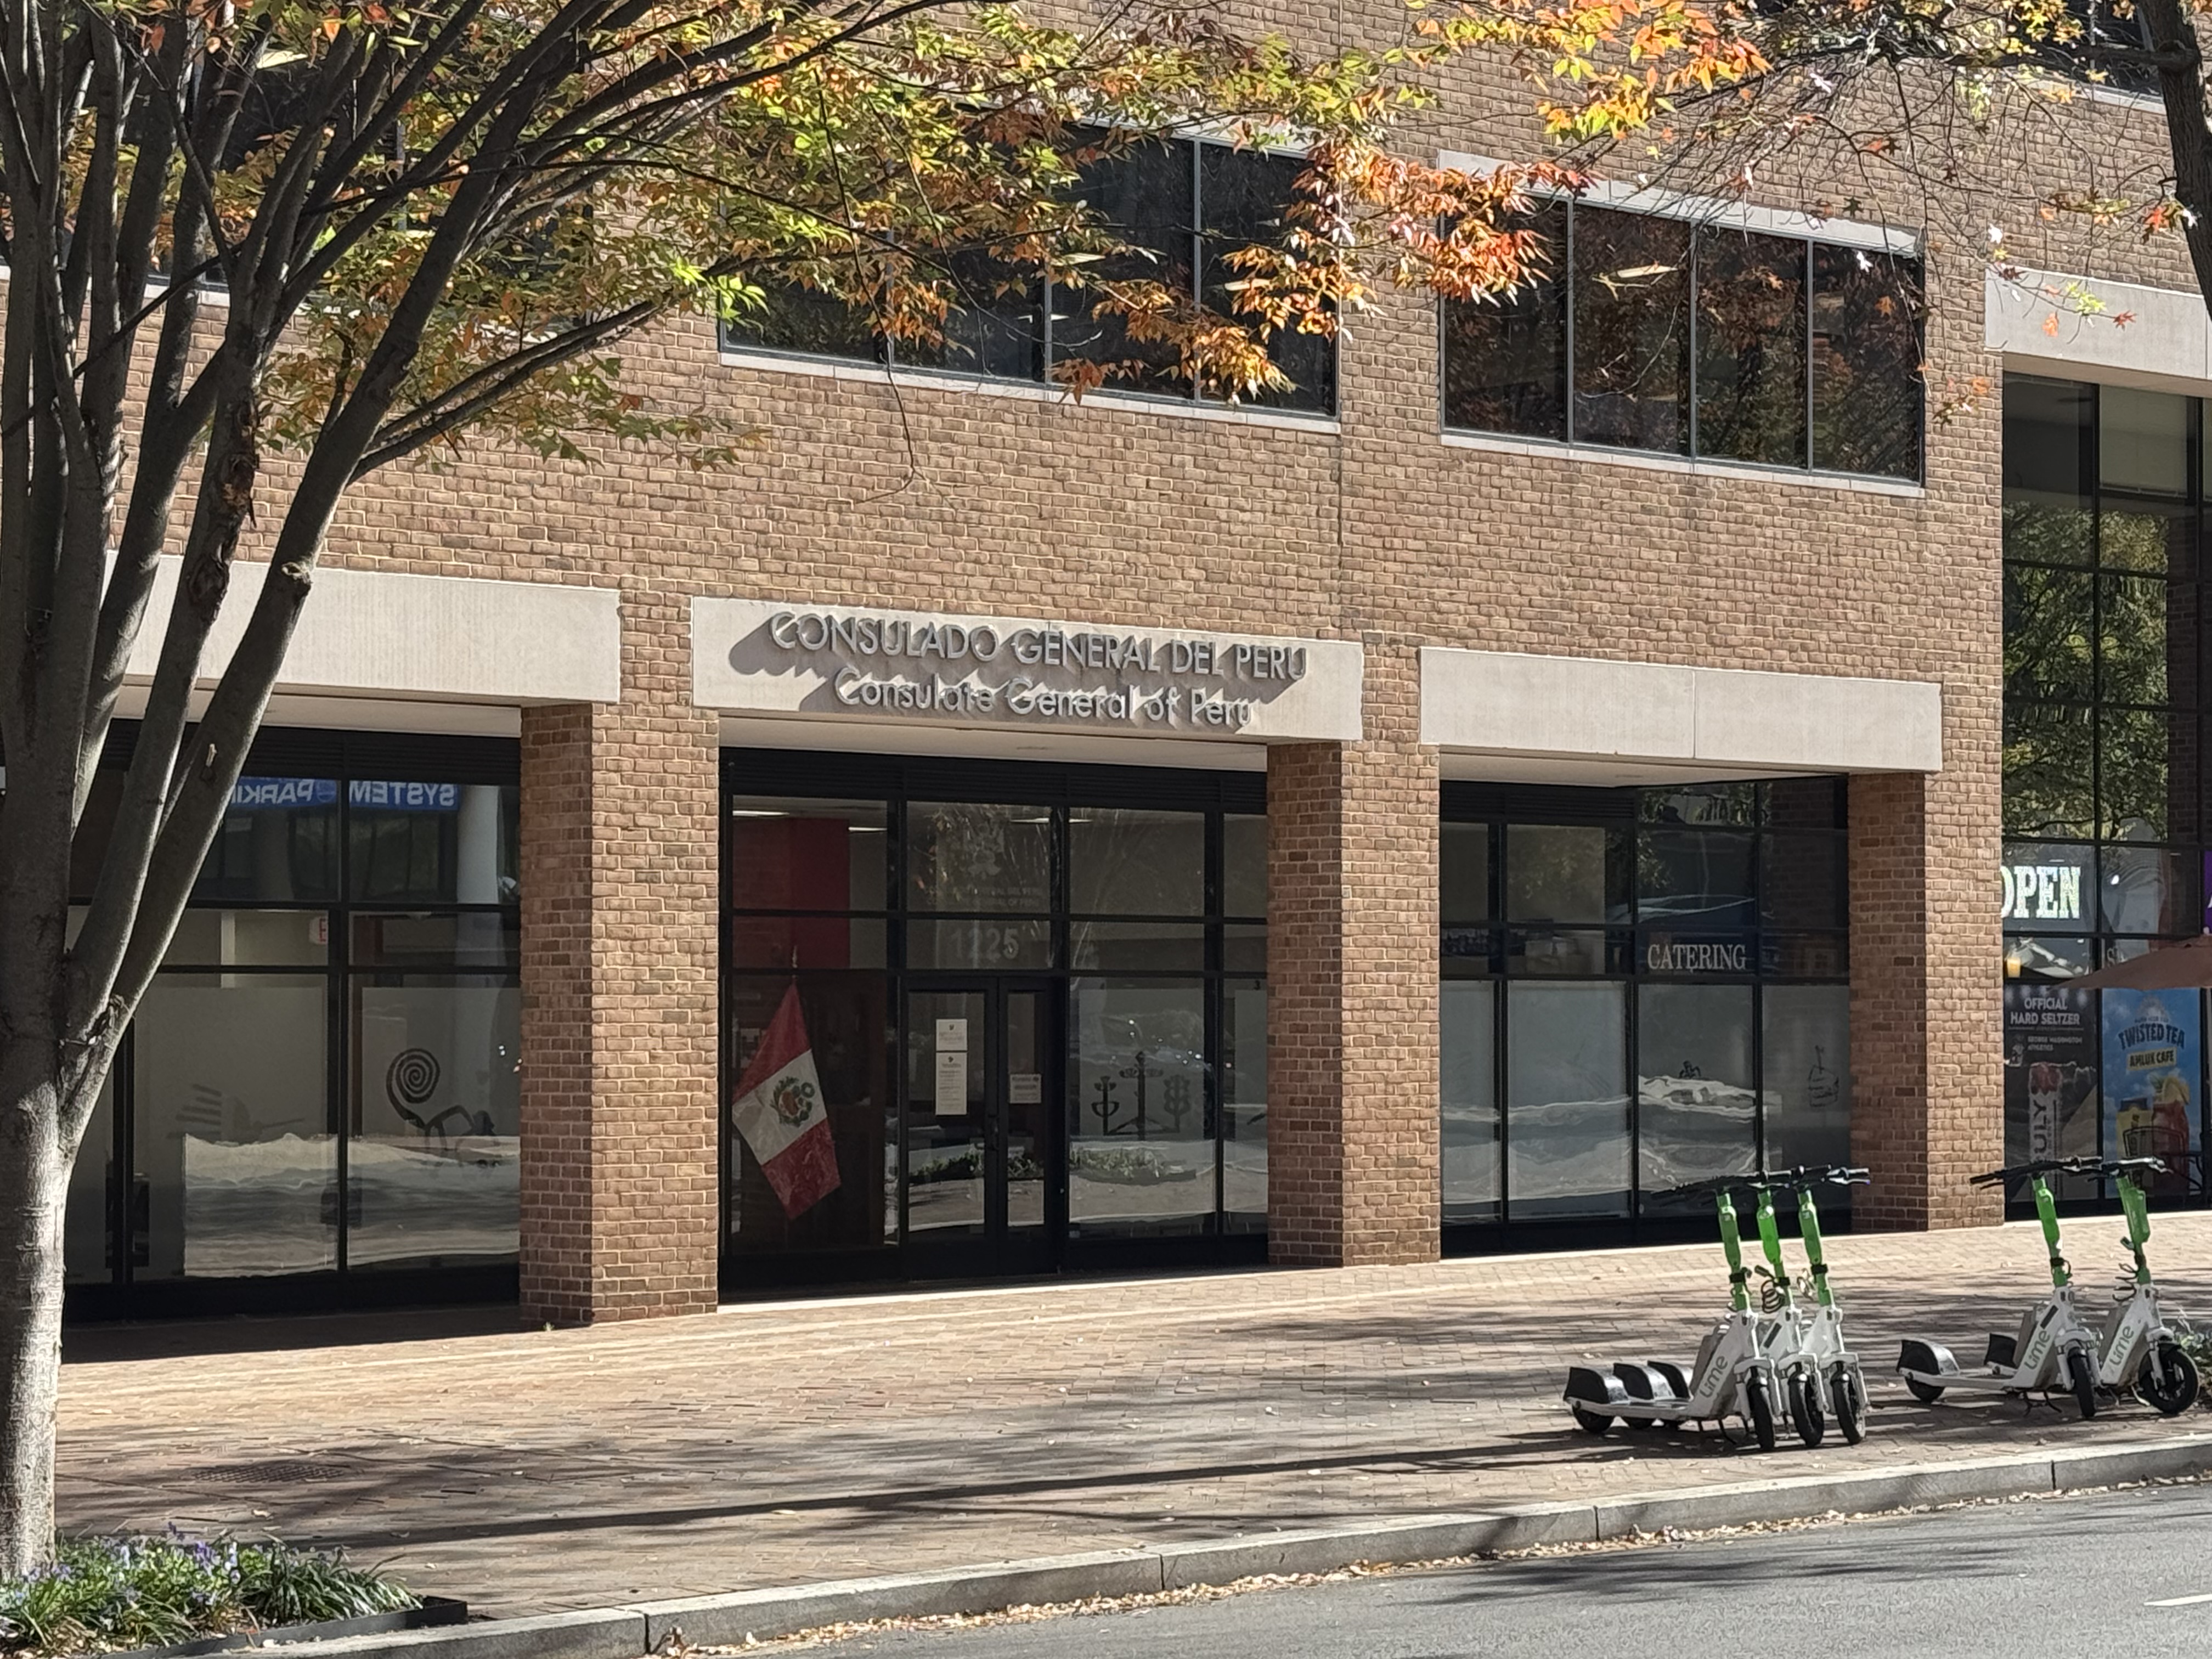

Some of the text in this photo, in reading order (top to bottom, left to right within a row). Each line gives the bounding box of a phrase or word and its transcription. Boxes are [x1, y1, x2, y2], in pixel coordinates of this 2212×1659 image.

[769, 611, 1307, 681] CONSULADO GENERAL DEL PERU
[834, 663, 1252, 726] Consulate General of Peru
[951, 927, 1019, 960] 1225
[1647, 943, 1746, 970] CATERING
[2010, 1011, 2080, 1025] HARD SELTZER
[2024, 997, 2068, 1010] OFFICIAL
[2118, 1023, 2185, 1050] TWISTED TEA
[2024, 1330, 2051, 1370] Lime
[2109, 1325, 2134, 1365] Lime
[1700, 1355, 1728, 1398] Lime
